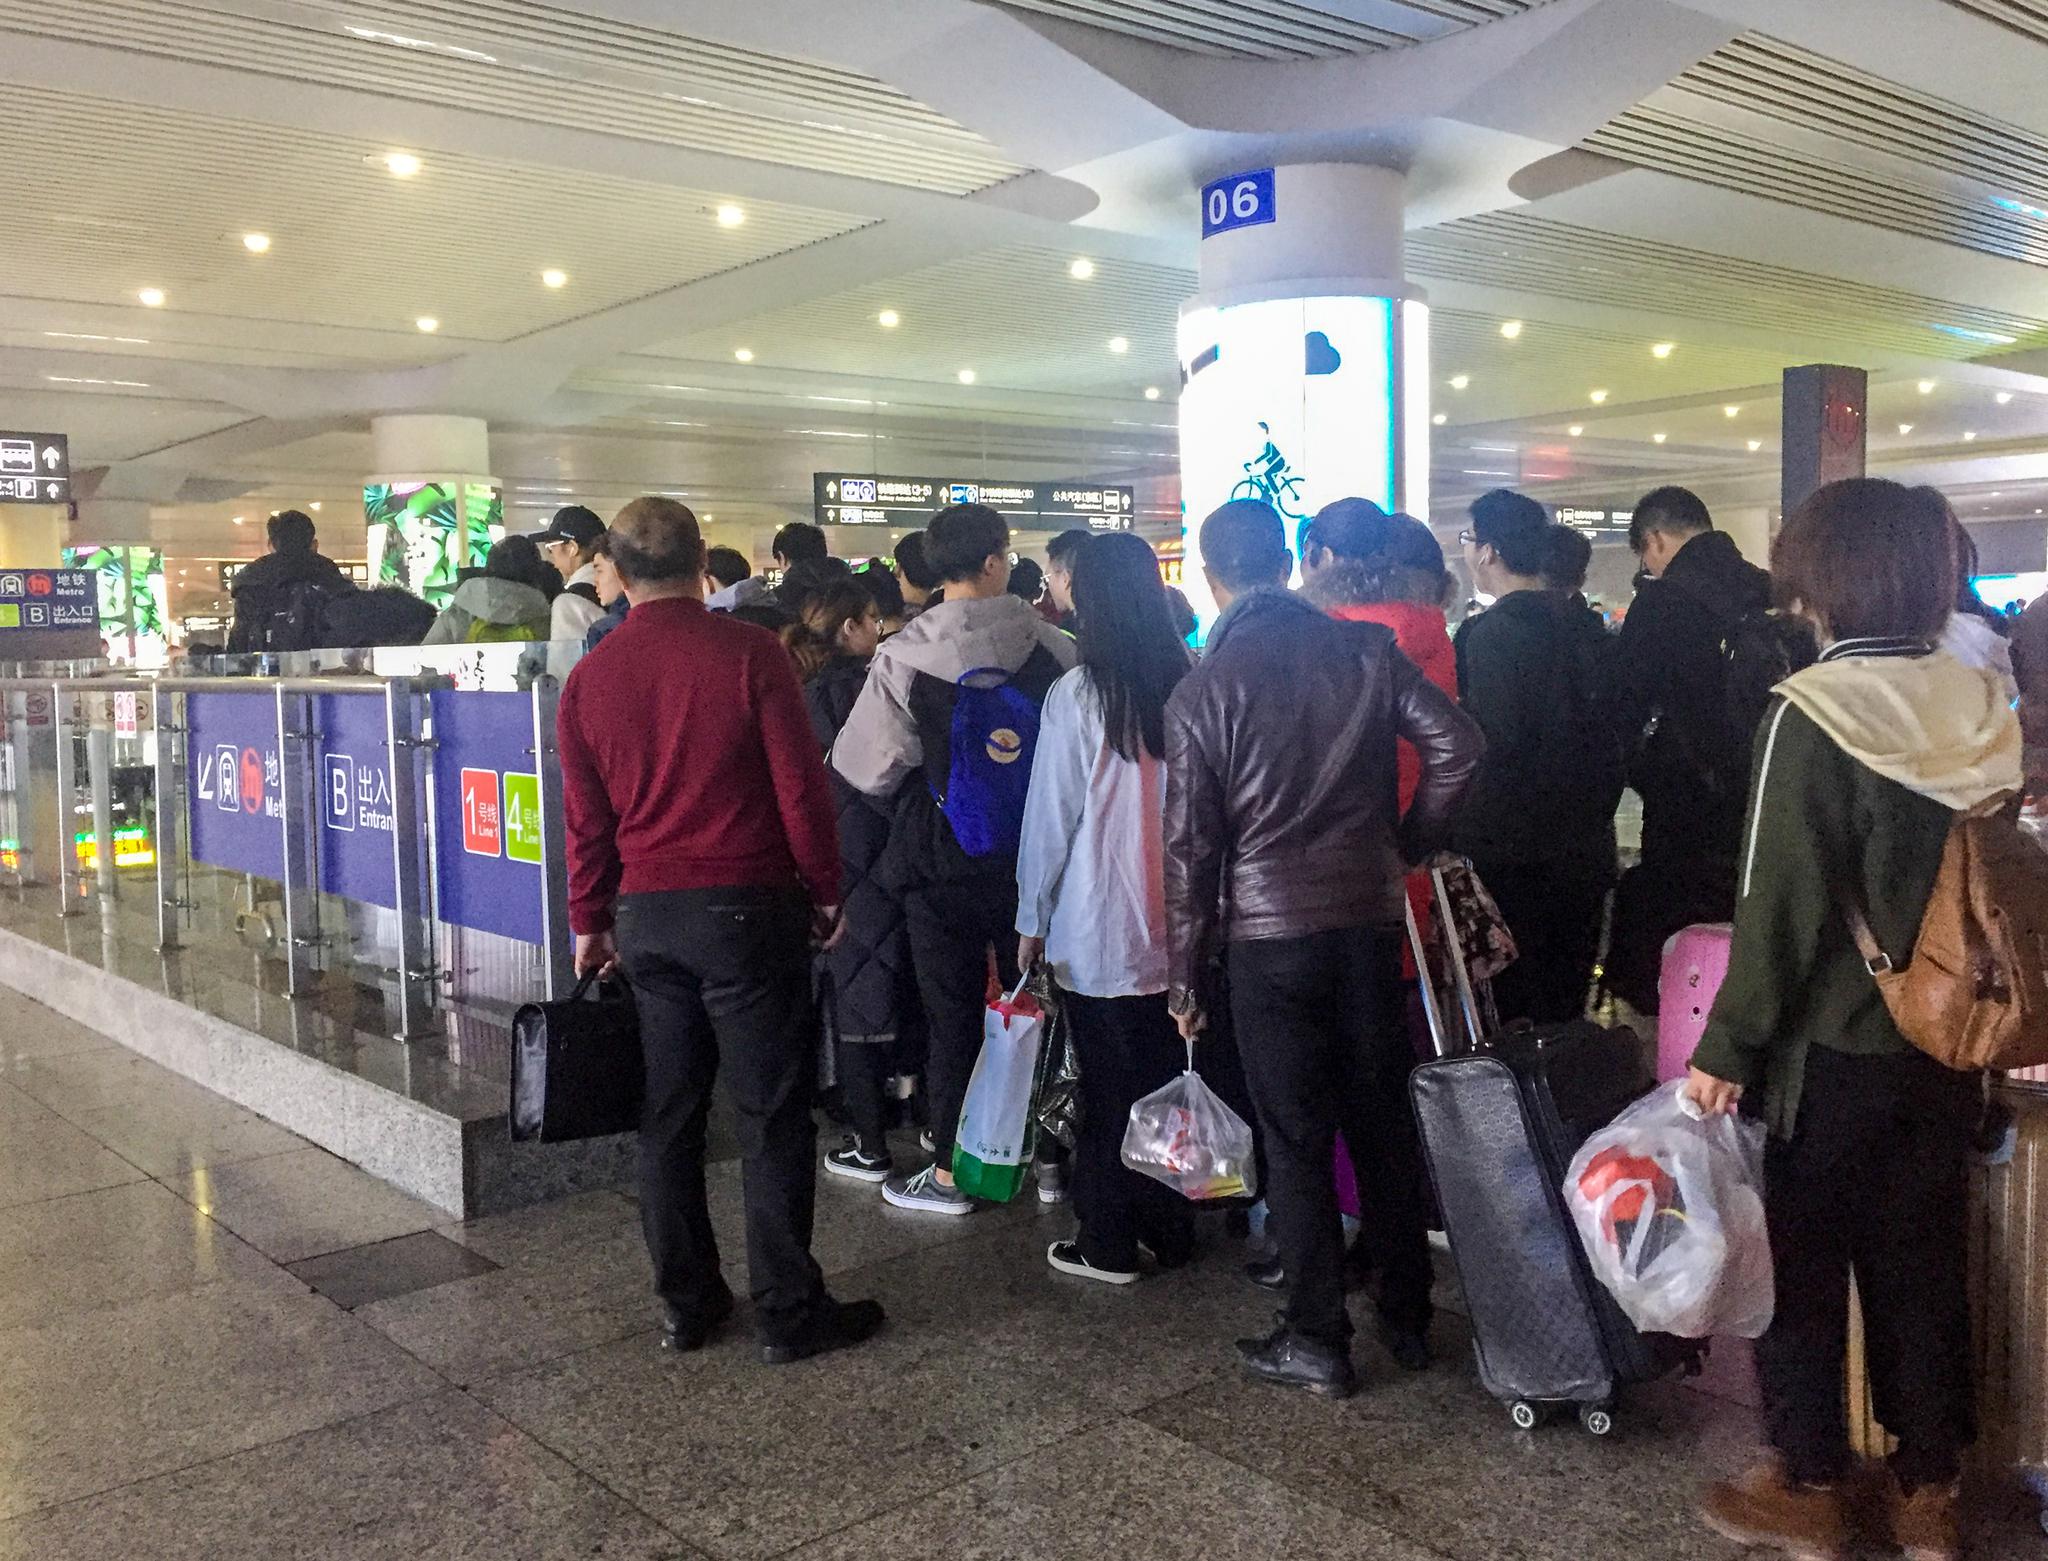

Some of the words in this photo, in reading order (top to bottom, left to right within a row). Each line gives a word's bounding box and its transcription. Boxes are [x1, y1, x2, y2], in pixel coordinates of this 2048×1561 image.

[1208, 181, 1259, 225] 06
[56, 573, 86, 586] 地铁
[56, 588, 85, 596] Metro
[30, 607, 44, 622] B
[52, 605, 93, 617] 出入口
[264, 750, 279, 787] 地
[332, 768, 348, 816] B
[358, 765, 391, 805] 出入
[265, 796, 283, 818] Met
[359, 806, 393, 831] Entran
[465, 786, 476, 835] 1
[478, 802, 497, 824] 号线
[508, 791, 523, 842] 4
[478, 825, 494, 838] Line
